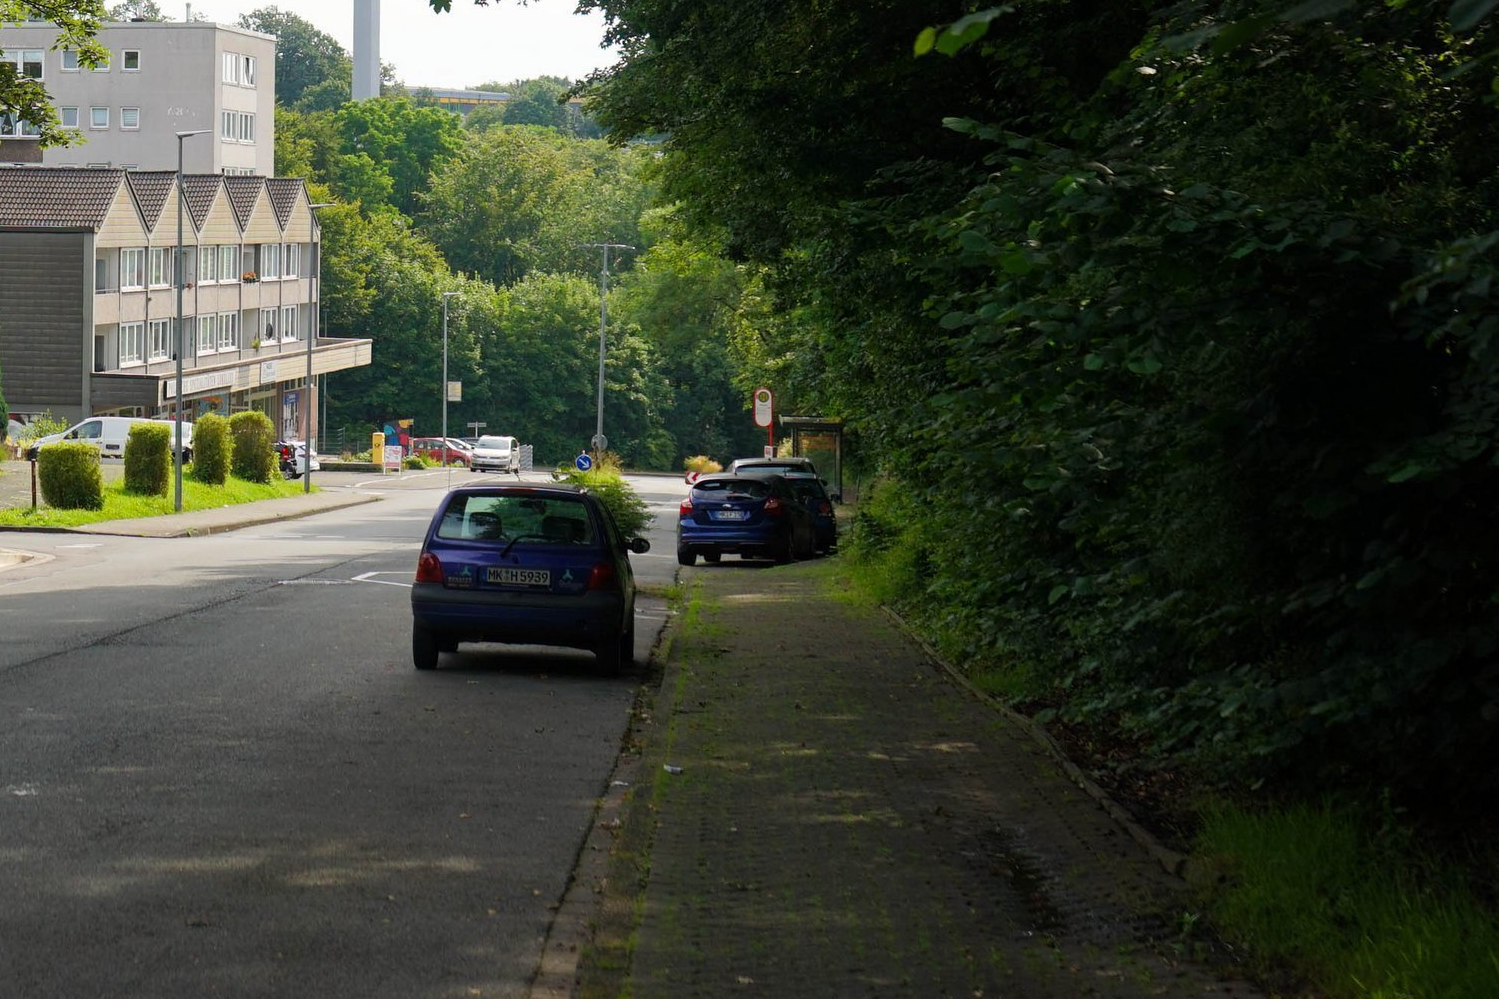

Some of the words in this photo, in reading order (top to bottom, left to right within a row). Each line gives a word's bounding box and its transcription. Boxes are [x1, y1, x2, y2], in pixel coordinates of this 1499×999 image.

[488, 569, 502, 580] MK
[510, 571, 518, 581] H
[521, 571, 549, 583] 5939
